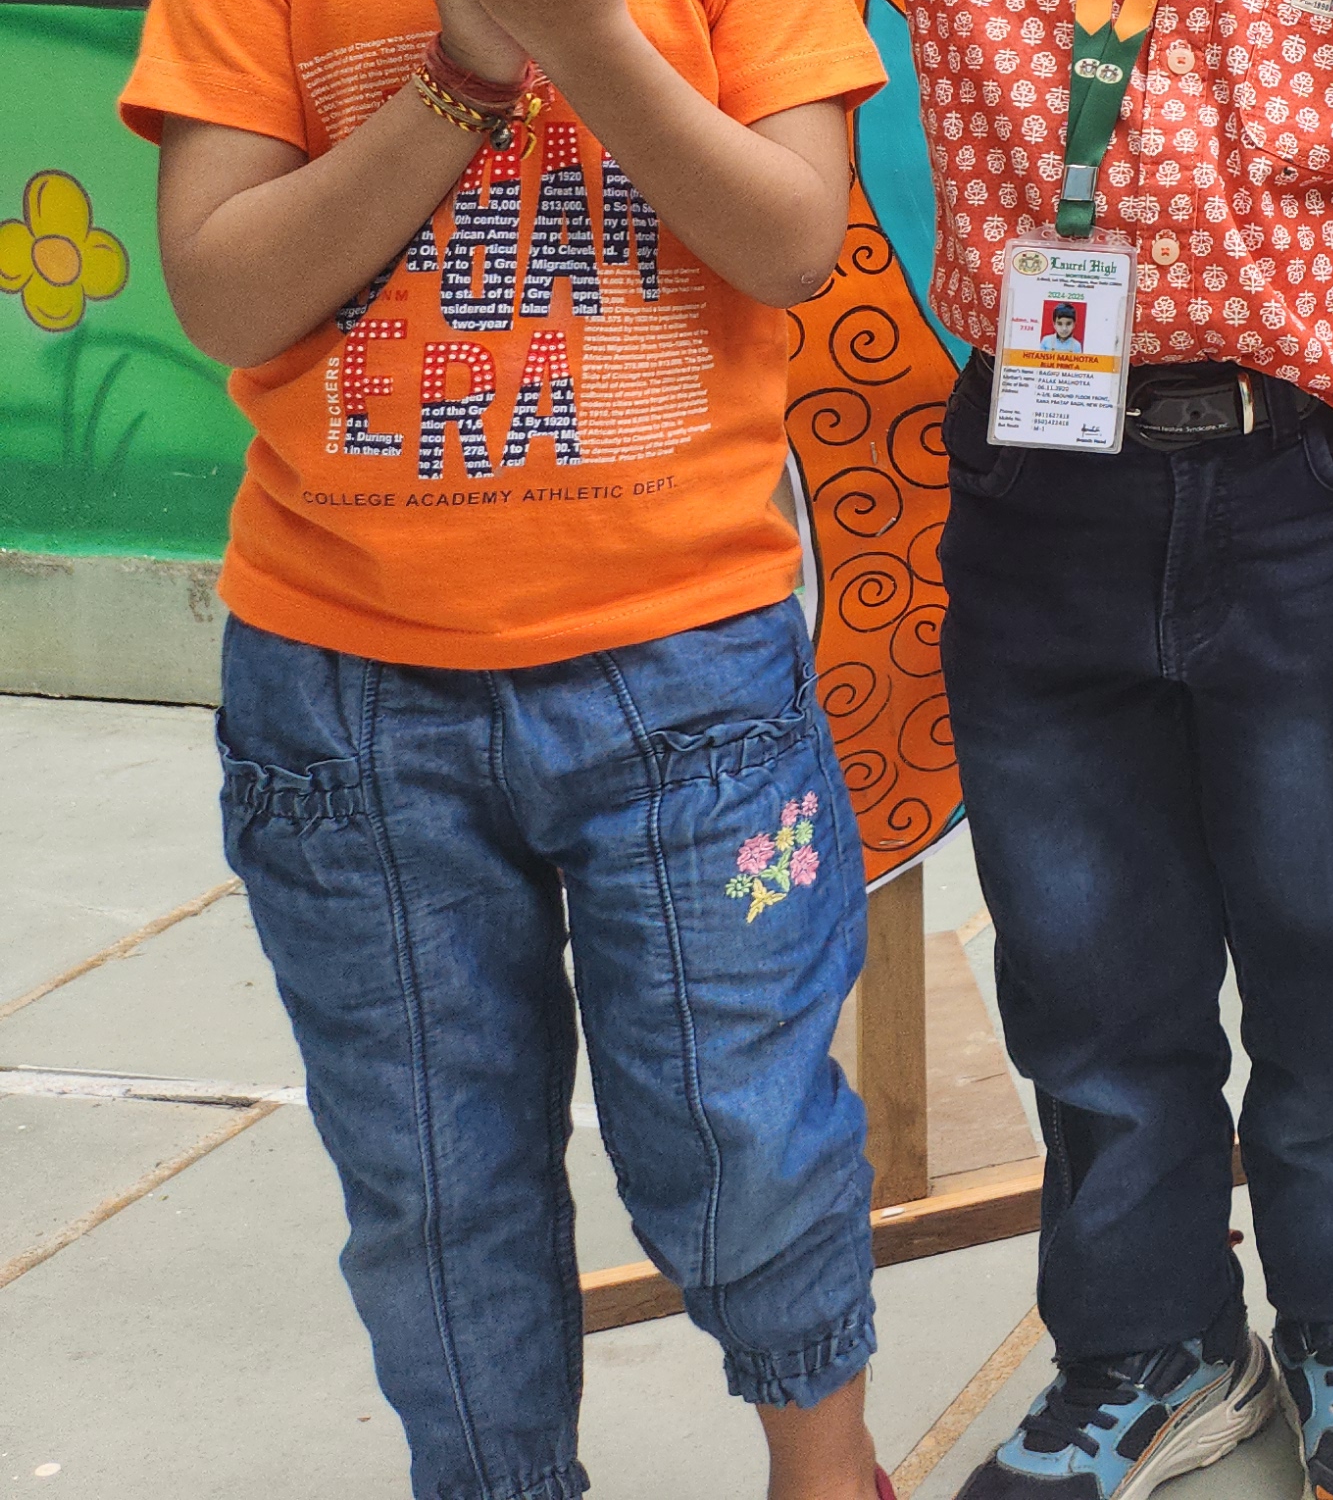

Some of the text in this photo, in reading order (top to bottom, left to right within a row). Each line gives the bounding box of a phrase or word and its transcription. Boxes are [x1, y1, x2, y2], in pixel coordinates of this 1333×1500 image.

[558, 171, 582, 181] 1920
[473, 216, 519, 227] century
[531, 259, 590, 272] Migration,
[1050, 257, 1117, 276] Laurel High
[1047, 291, 1085, 300] 2024-2025
[452, 319, 507, 330] two-year
[1057, 354, 1099, 363] MALHOTRA
[343, 318, 583, 480] ERA
[326, 356, 340, 454] CHECKERS
[447, 406, 466, 415] the
[525, 417, 570, 428] By 1920
[357, 432, 391, 444] During
[362, 446, 378, 455] the
[302, 474, 678, 508] COLLEGE ACADEMY ATHLETIC DEPT.
